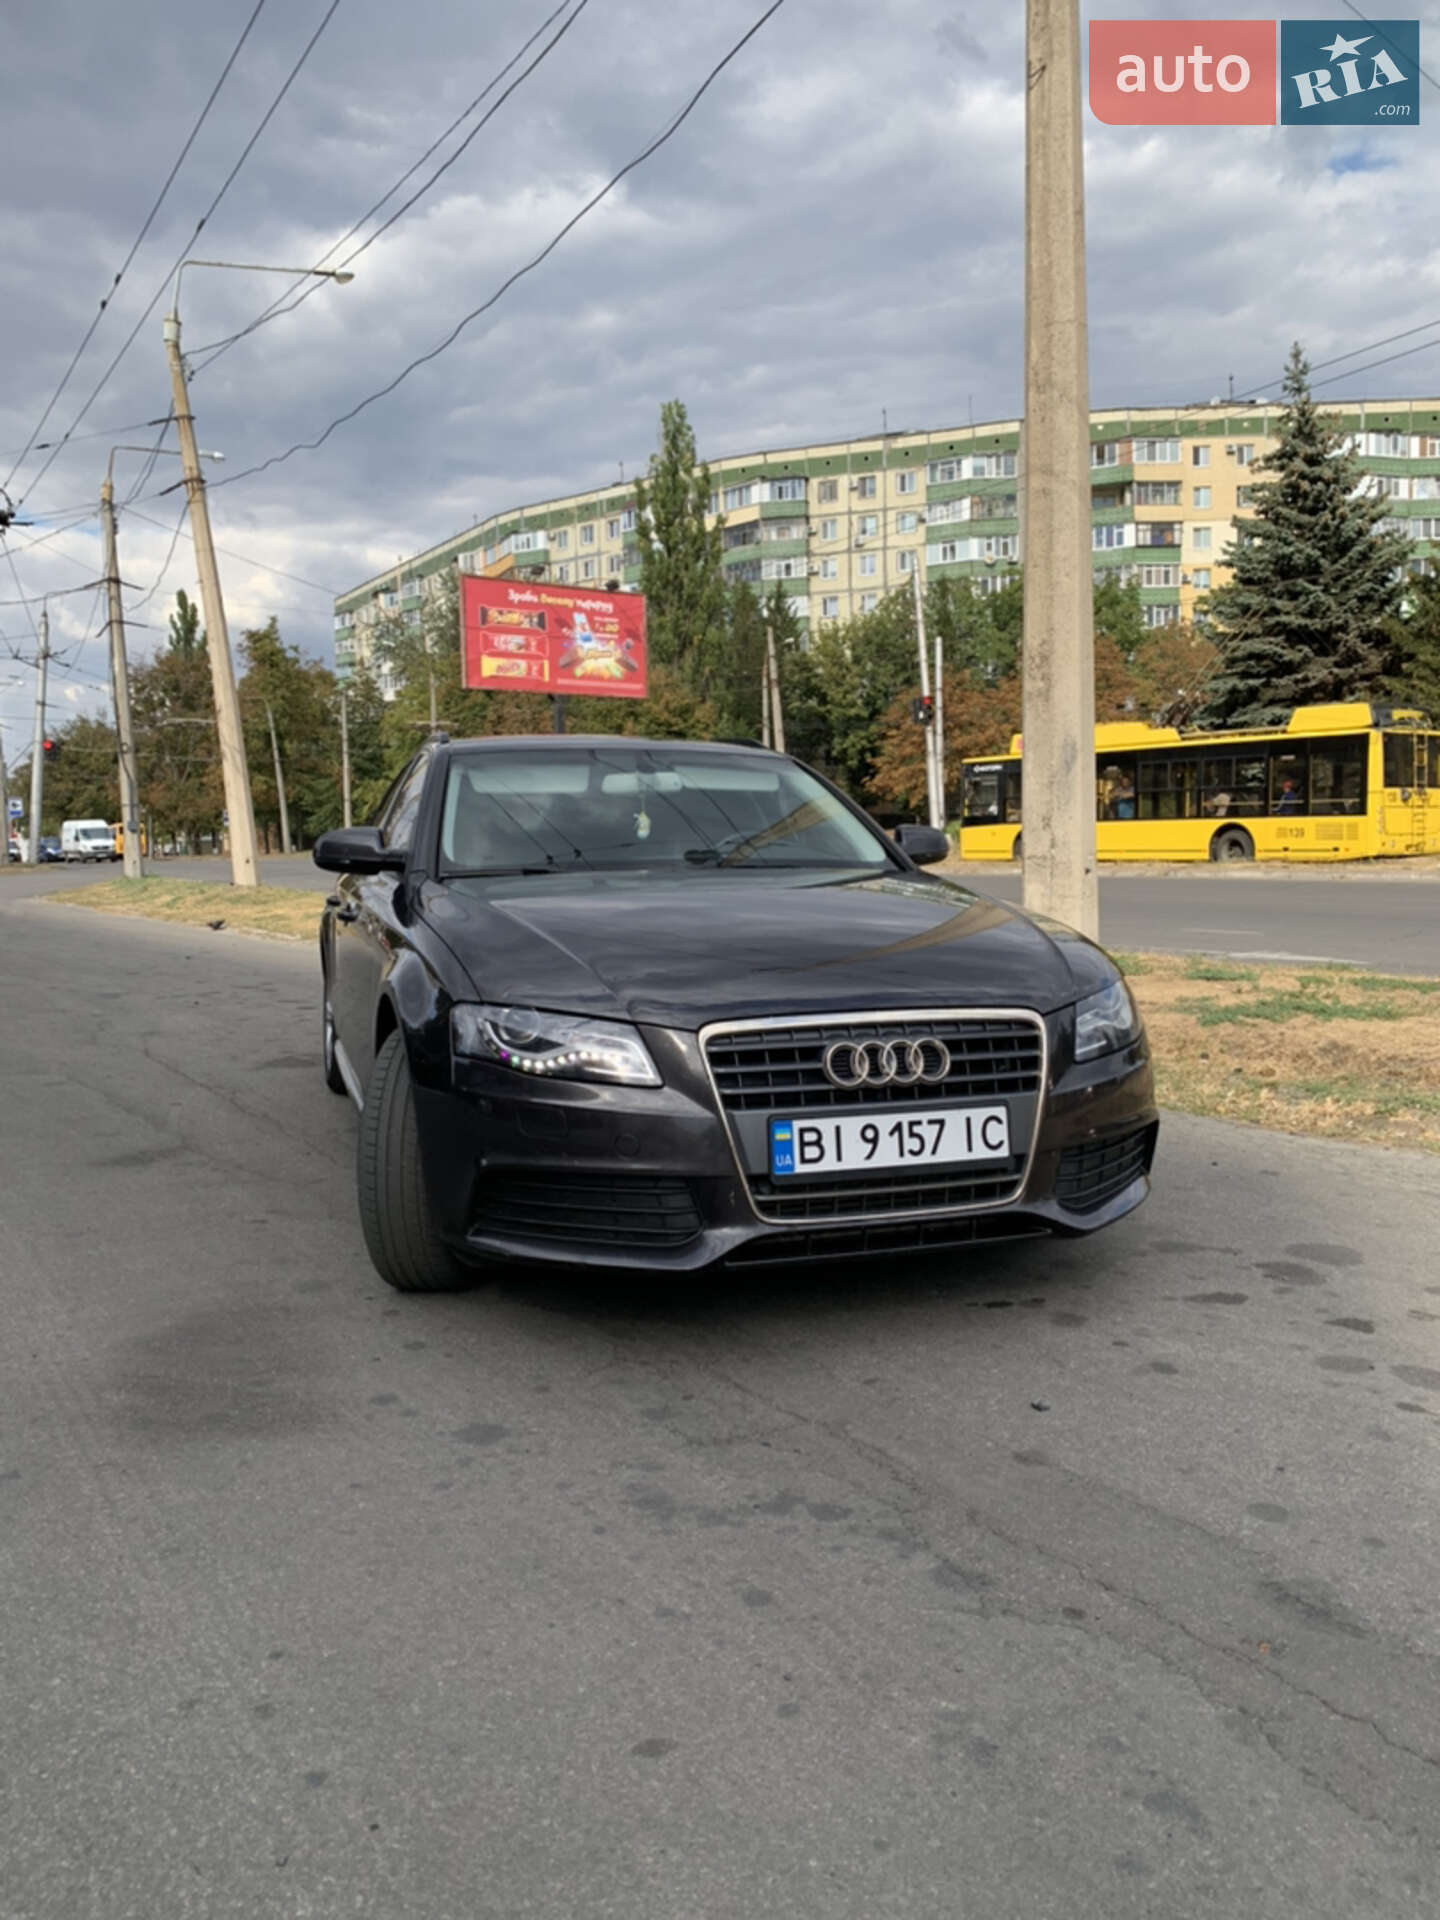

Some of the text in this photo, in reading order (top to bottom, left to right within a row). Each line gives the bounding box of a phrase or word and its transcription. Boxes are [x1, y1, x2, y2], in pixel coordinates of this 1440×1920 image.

[798, 1115, 1005, 1164] BI 9157 IC
[775, 1153, 793, 1167] UA
